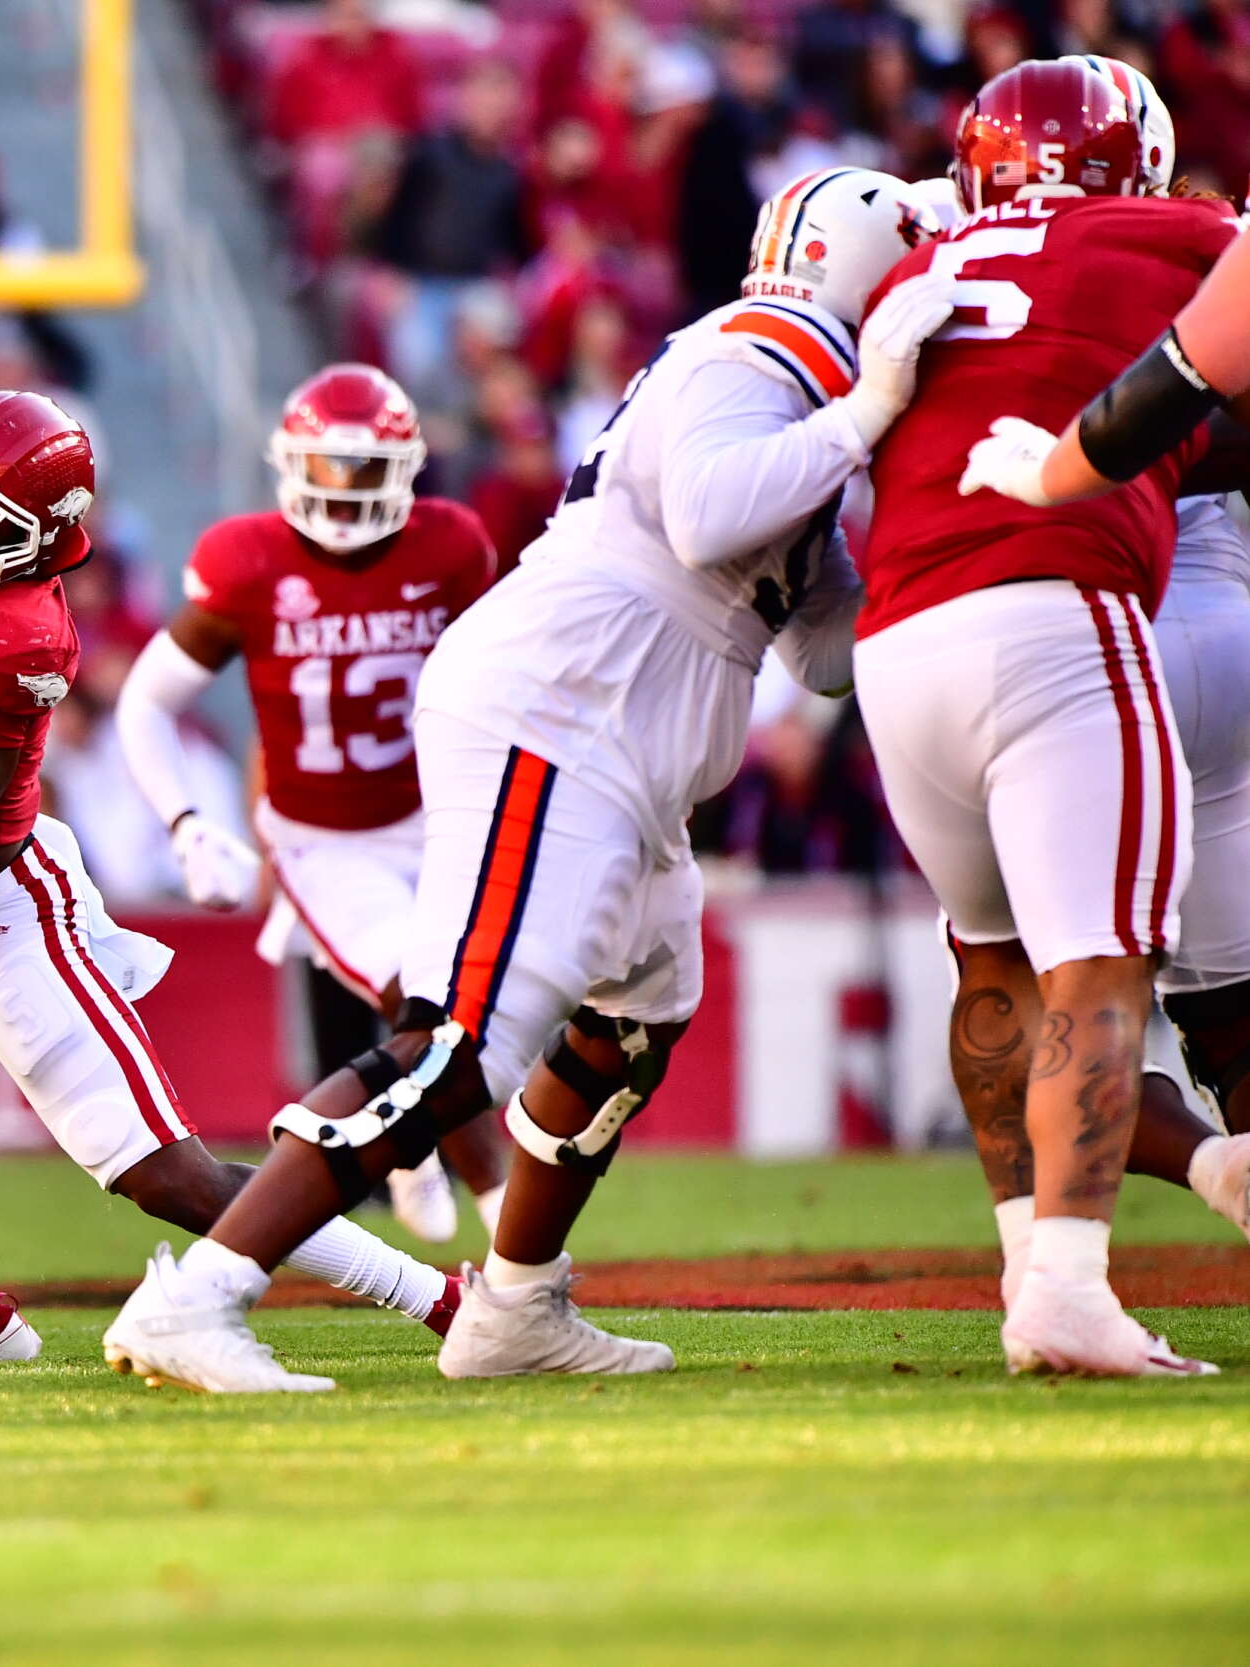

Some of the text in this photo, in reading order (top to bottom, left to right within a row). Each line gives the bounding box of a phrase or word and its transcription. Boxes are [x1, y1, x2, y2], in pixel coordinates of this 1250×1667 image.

[1038, 142, 1065, 184] 5
[928, 221, 1049, 341] 5
[290, 653, 427, 774] 13
